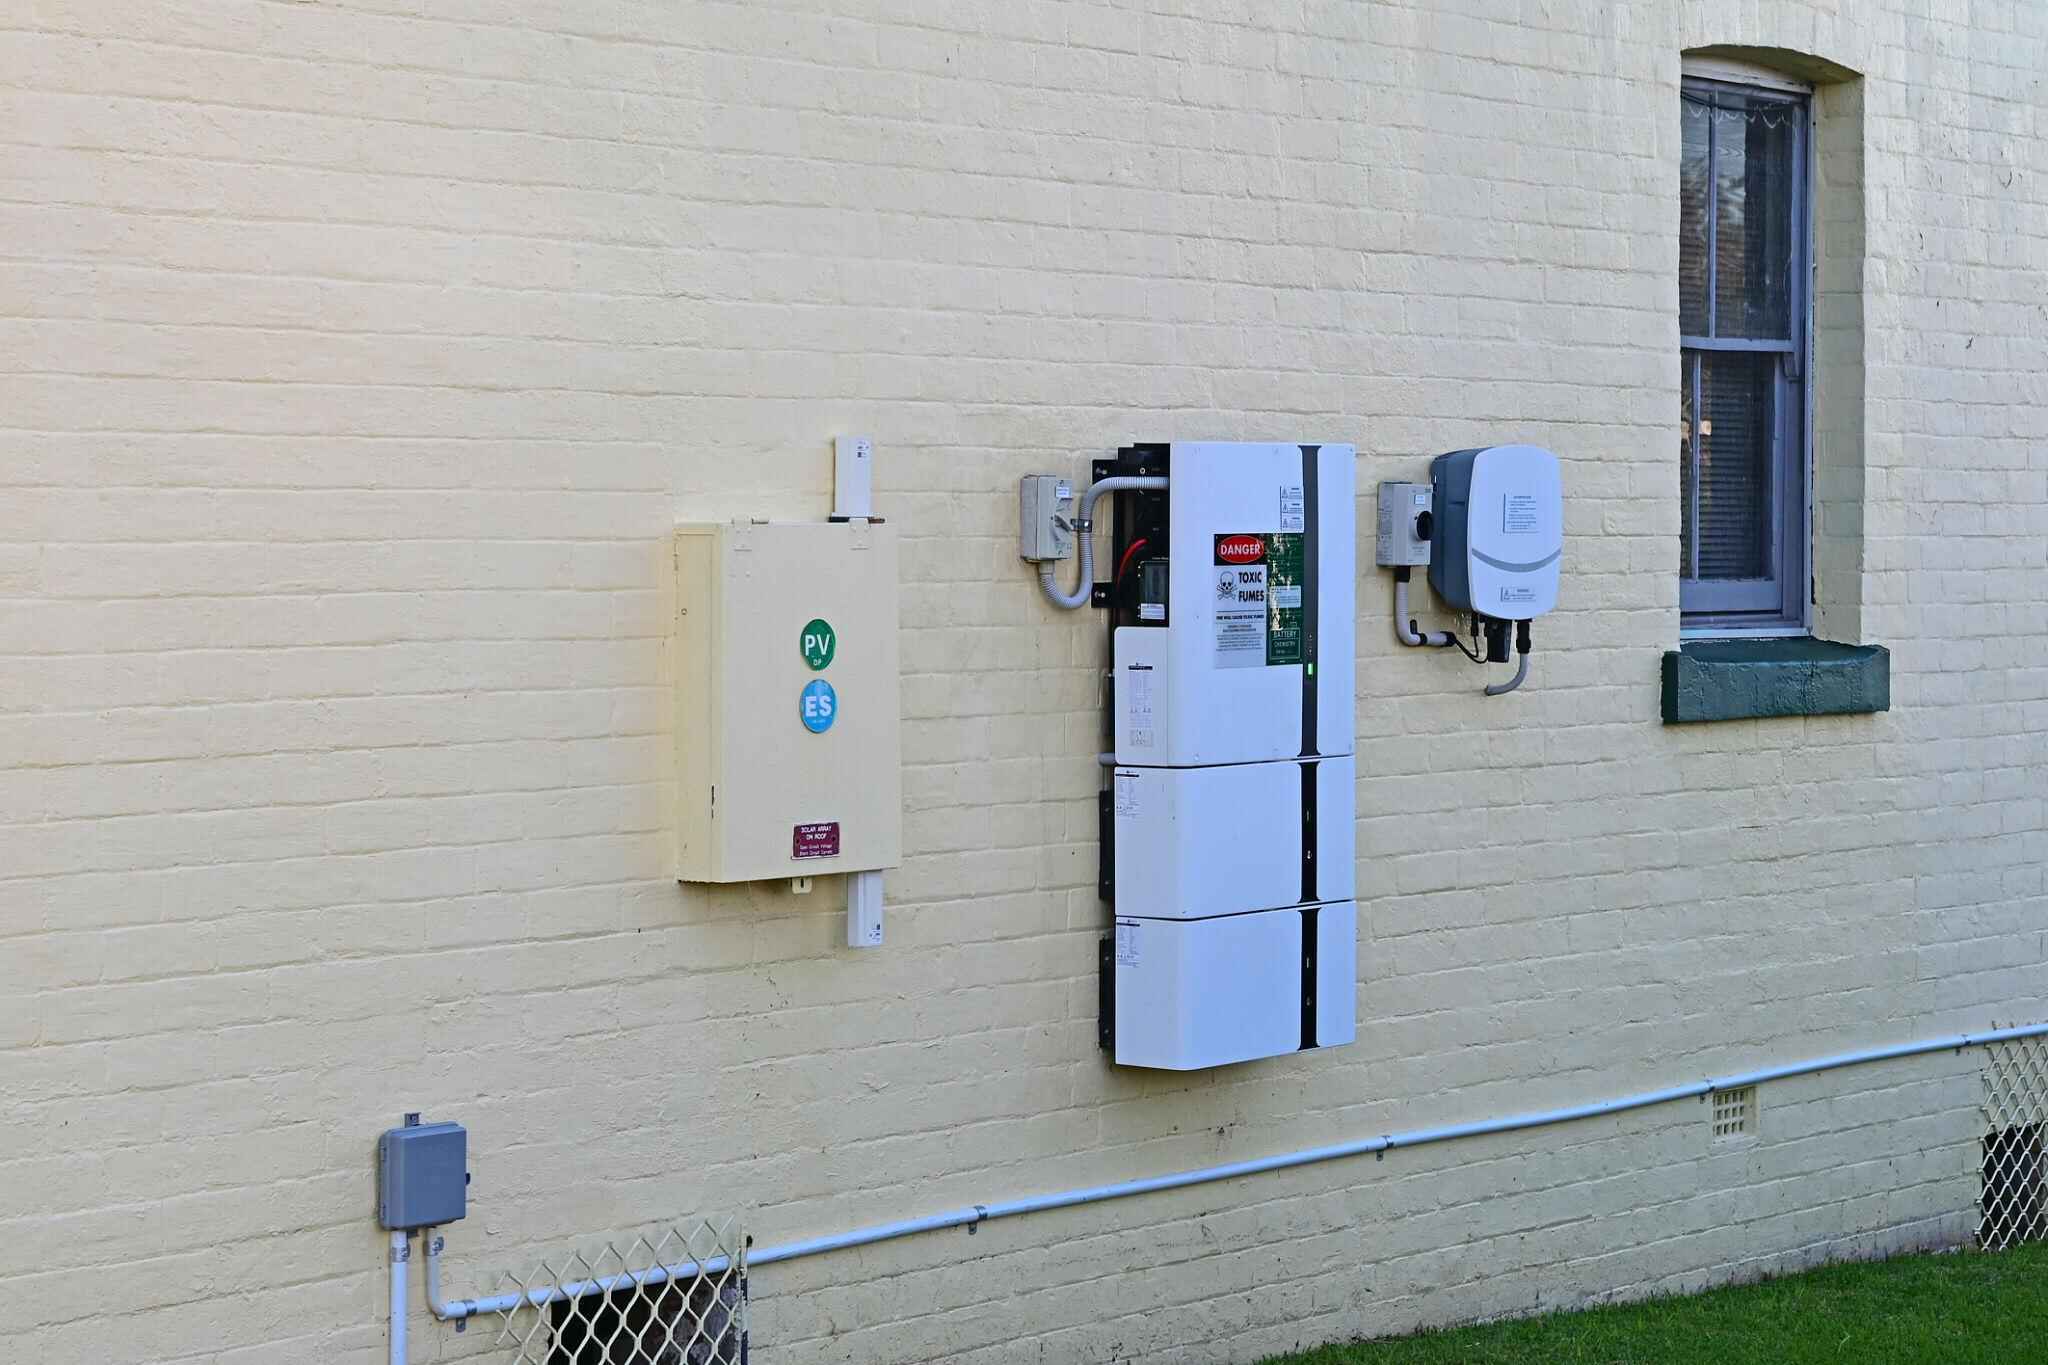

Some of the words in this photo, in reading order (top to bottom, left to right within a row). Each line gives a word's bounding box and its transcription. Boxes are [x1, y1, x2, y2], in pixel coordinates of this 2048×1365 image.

[1220, 543, 1261, 556] DANGER
[1238, 571, 1262, 584] TOXIC
[1238, 590, 1265, 603] FUMES
[1273, 630, 1297, 638] BATTERY
[804, 633, 831, 656] PV
[805, 695, 832, 717] ES
